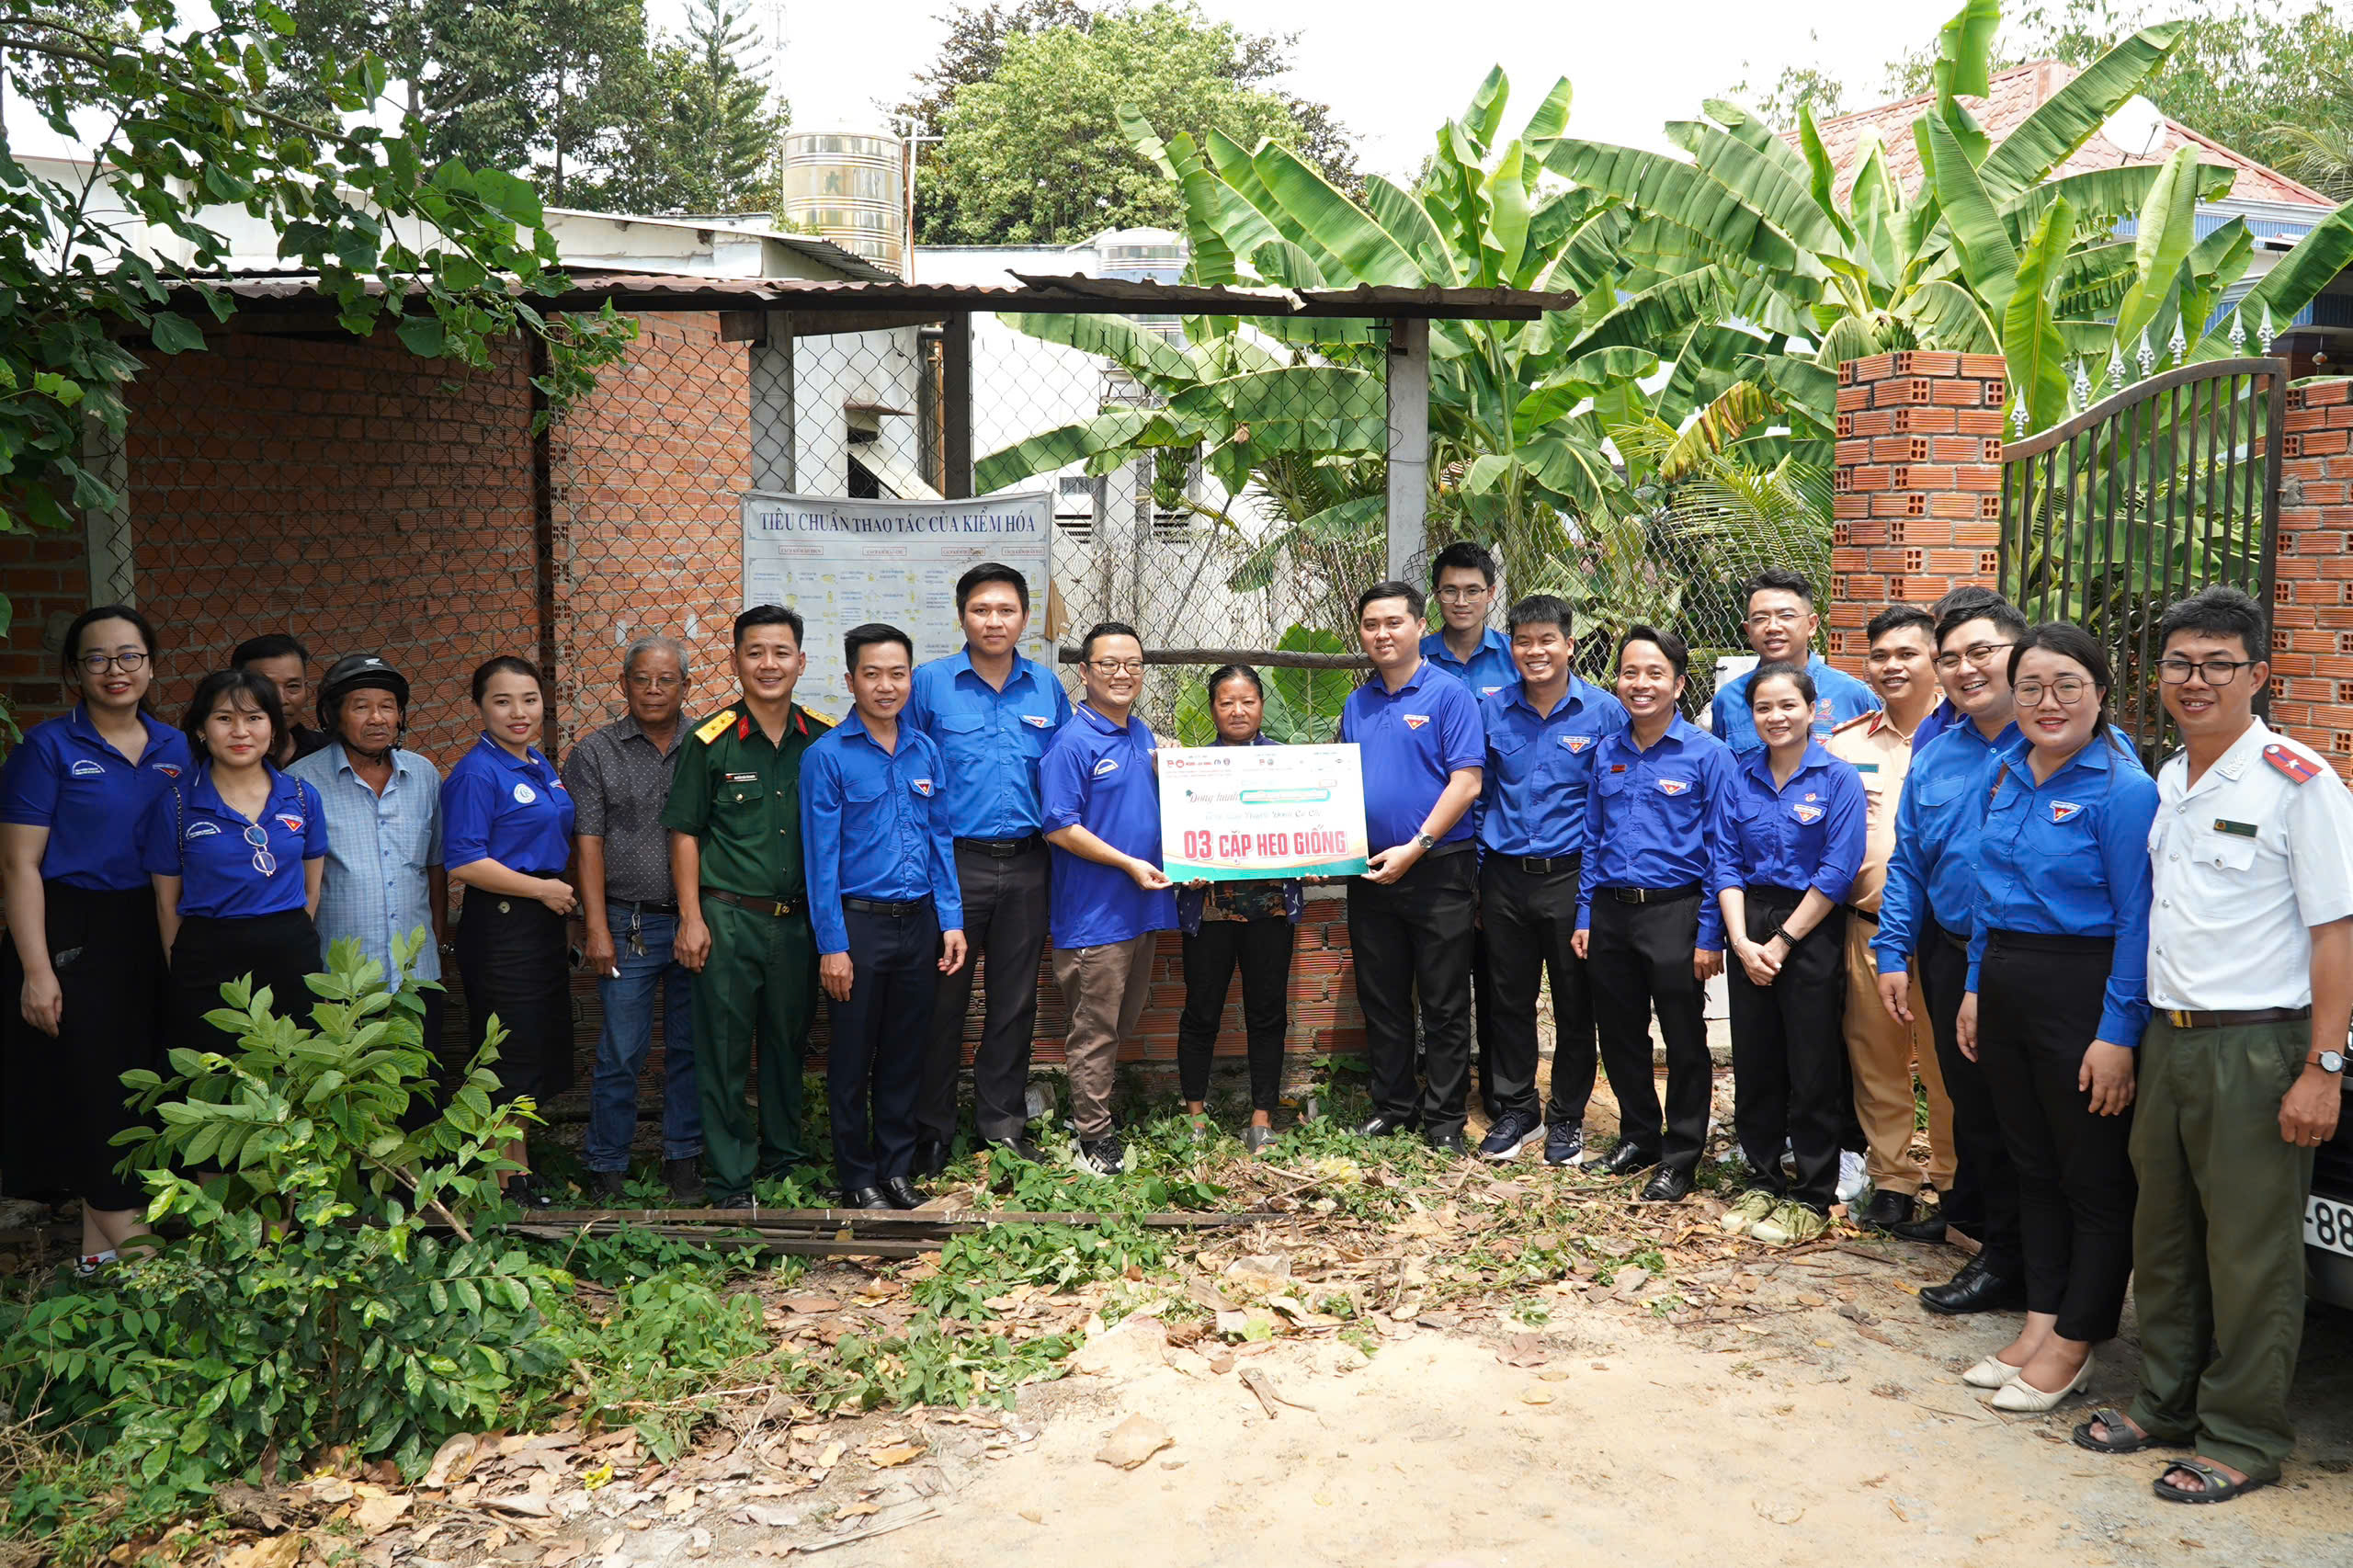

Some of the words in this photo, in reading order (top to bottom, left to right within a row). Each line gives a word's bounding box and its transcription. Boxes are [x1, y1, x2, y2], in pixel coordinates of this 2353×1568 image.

[760, 507, 794, 530] TIÊU
[799, 508, 849, 531] CHUẨN
[852, 517, 892, 533] THAO
[895, 513, 925, 533] TÁC
[928, 510, 959, 533] CỦA
[962, 506, 1001, 532] KIỂM
[1006, 510, 1035, 532] HÓA
[1184, 830, 1212, 859] 03
[1219, 831, 1253, 864] CẶP
[1256, 833, 1289, 857] HEO
[1294, 824, 1347, 855] GIỐNG
